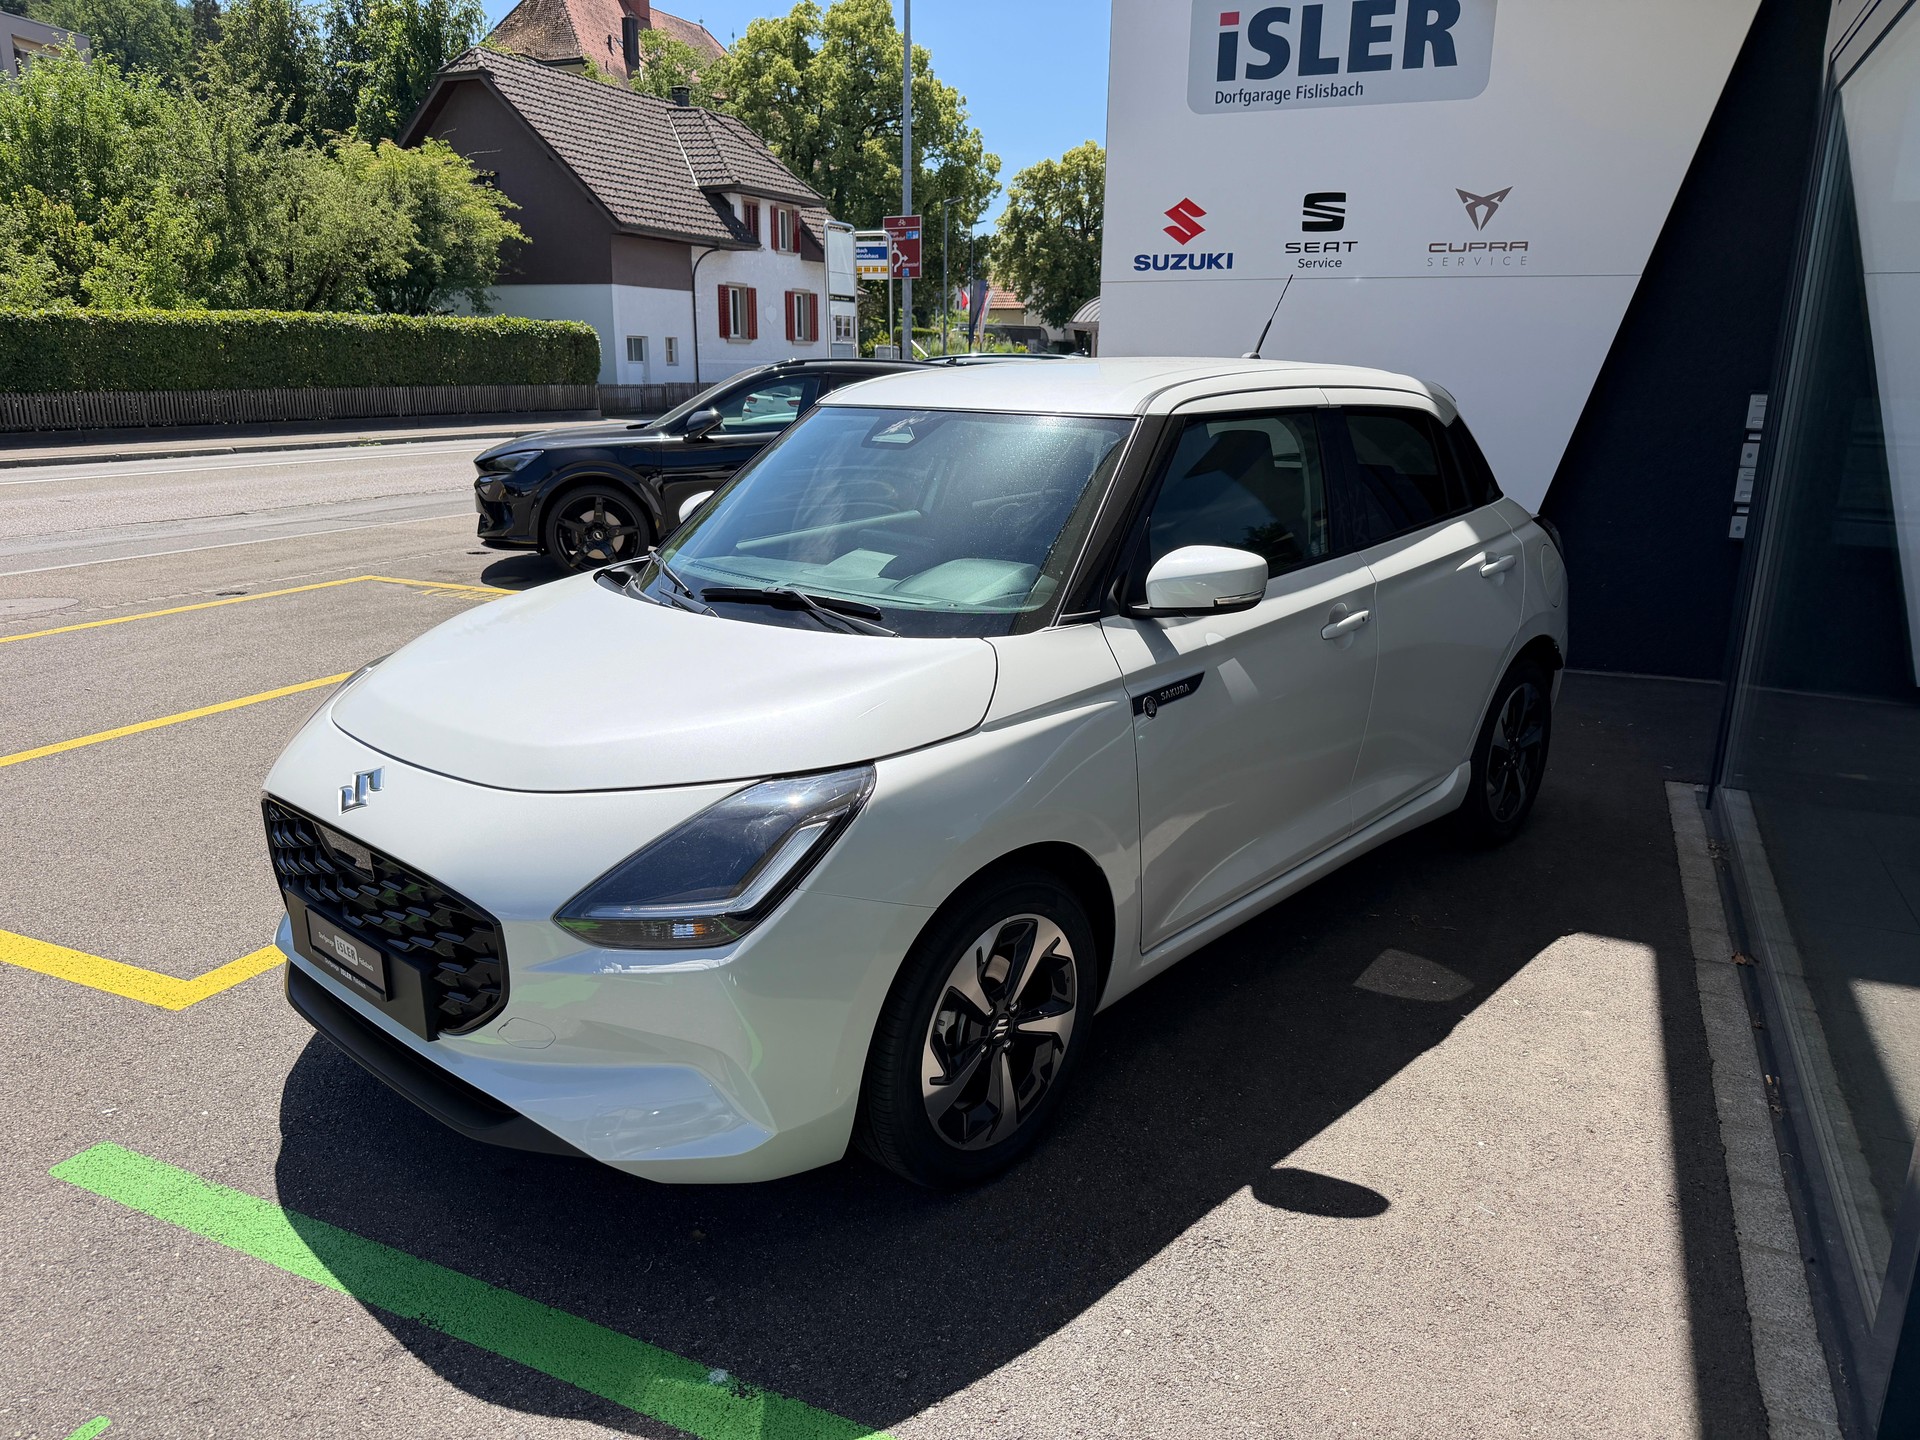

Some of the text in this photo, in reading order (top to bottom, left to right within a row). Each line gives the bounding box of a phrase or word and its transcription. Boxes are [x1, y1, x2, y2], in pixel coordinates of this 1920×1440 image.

[1215, 81, 1364, 107] Dorfgarage Fislisbach
[1285, 241, 1358, 254] SEAT
[1428, 241, 1529, 253] CUPRA
[1133, 252, 1234, 271] SUZUKI
[1297, 257, 1343, 269] Service
[1427, 256, 1528, 267] SERVICE
[1160, 683, 1190, 701] SAKURA
